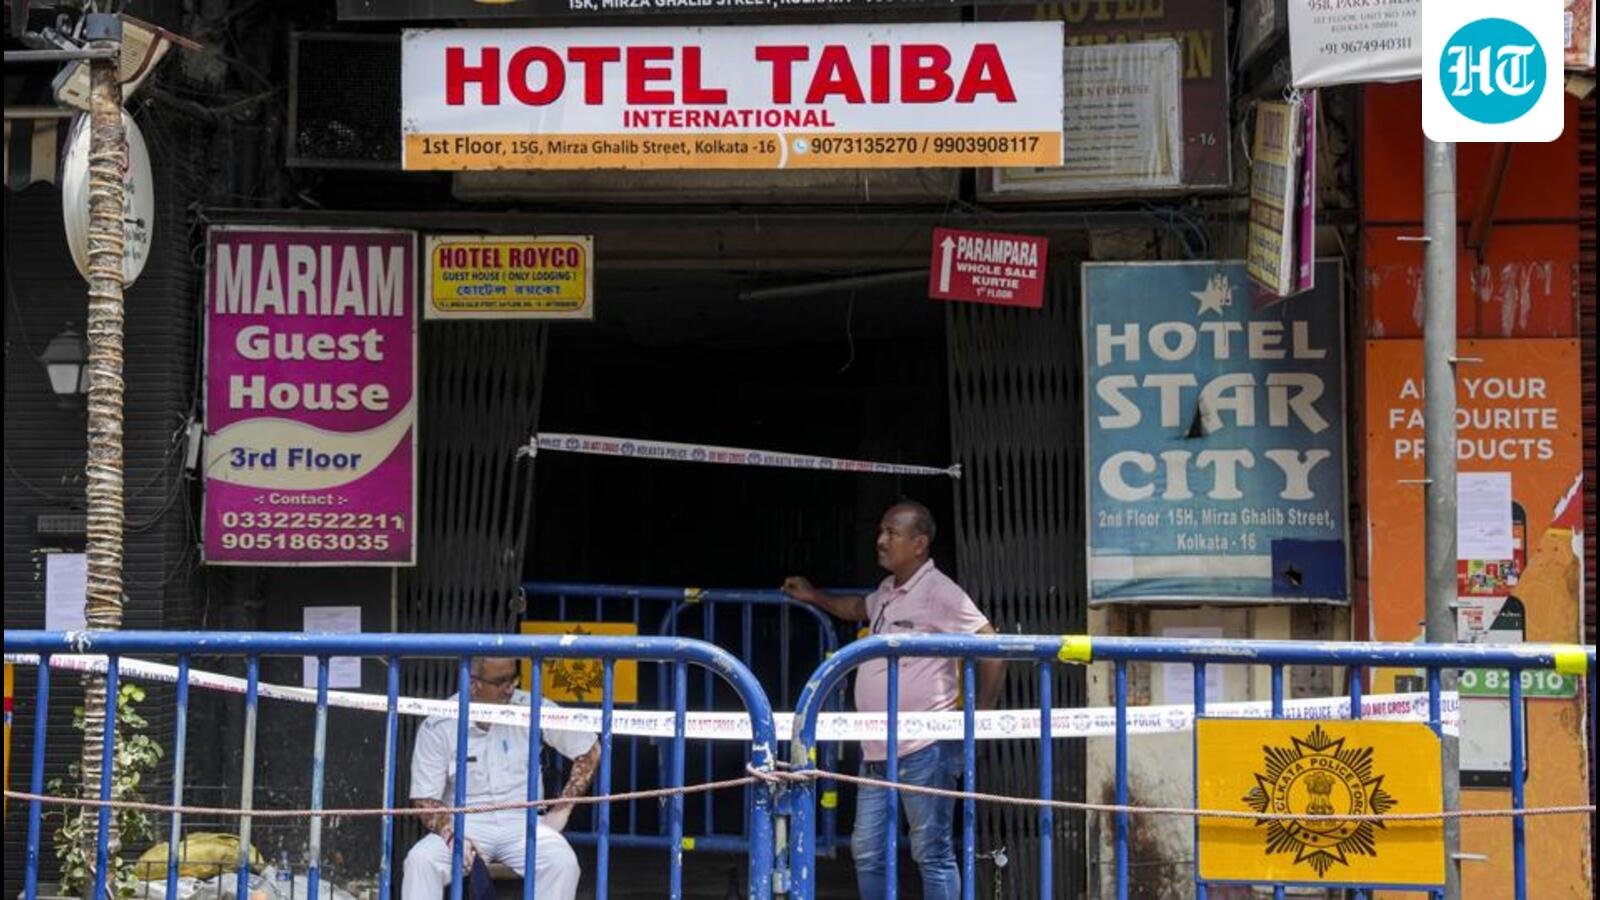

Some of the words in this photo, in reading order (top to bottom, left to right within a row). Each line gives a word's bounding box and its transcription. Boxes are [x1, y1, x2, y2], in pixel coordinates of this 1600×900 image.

[1341, 37, 1412, 54] 9674940311
[445, 46, 727, 106] HOTEL
[755, 43, 1017, 104] TAIBA
[623, 109, 835, 128] INTERNATIONAL
[422, 137, 449, 155] 1st
[454, 138, 506, 156] Floor,
[511, 140, 543, 156] 15G,
[547, 140, 588, 154] Mirza
[592, 139, 639, 155] Ghalib
[643, 139, 691, 157] Street,
[695, 138, 748, 154] Kolkata
[811, 138, 917, 154] 9073135270
[934, 137, 1039, 154] 9903908117
[439, 247, 503, 269] HOTEL
[509, 247, 580, 269] ROYCO
[956, 236, 1038, 267] PARAMPARA
[215, 243, 404, 316] MARIAM
[442, 271, 469, 281] GUEST
[472, 271, 499, 281] HOUSE
[508, 271, 529, 281] ONLY
[957, 262, 1002, 276] WHOLE
[1004, 267, 1037, 279] SALE
[972, 275, 1020, 289] KURTIE
[235, 324, 385, 361] Guest
[1096, 321, 1328, 367] HOTEL
[229, 375, 390, 411] House
[1463, 378, 1547, 399] YOUR
[1096, 373, 1331, 434] STAR
[1389, 408, 1559, 429] FAOURITE
[229, 447, 277, 469] 3rd
[288, 447, 362, 469] Floor
[1395, 438, 1554, 460] PRDUCTS
[1099, 449, 1332, 501] CITY
[269, 492, 333, 505] Contact
[222, 511, 404, 530] 03322522211
[1099, 510, 1122, 527] 2nd
[1126, 510, 1160, 528] Floor
[1168, 508, 1199, 529] 15H,
[1201, 507, 1238, 526] Mirza
[1241, 506, 1284, 526] Ghalib
[1288, 508, 1335, 530] Street,
[221, 532, 390, 550] 9051863035
[1176, 532, 1229, 550] Kolkata
[1240, 532, 1257, 549] 16
[1372, 702, 1386, 715] NOT
[1387, 700, 1410, 714] CROSS
[1310, 758, 1355, 782] POLICE
[1351, 783, 1364, 824] FORC
